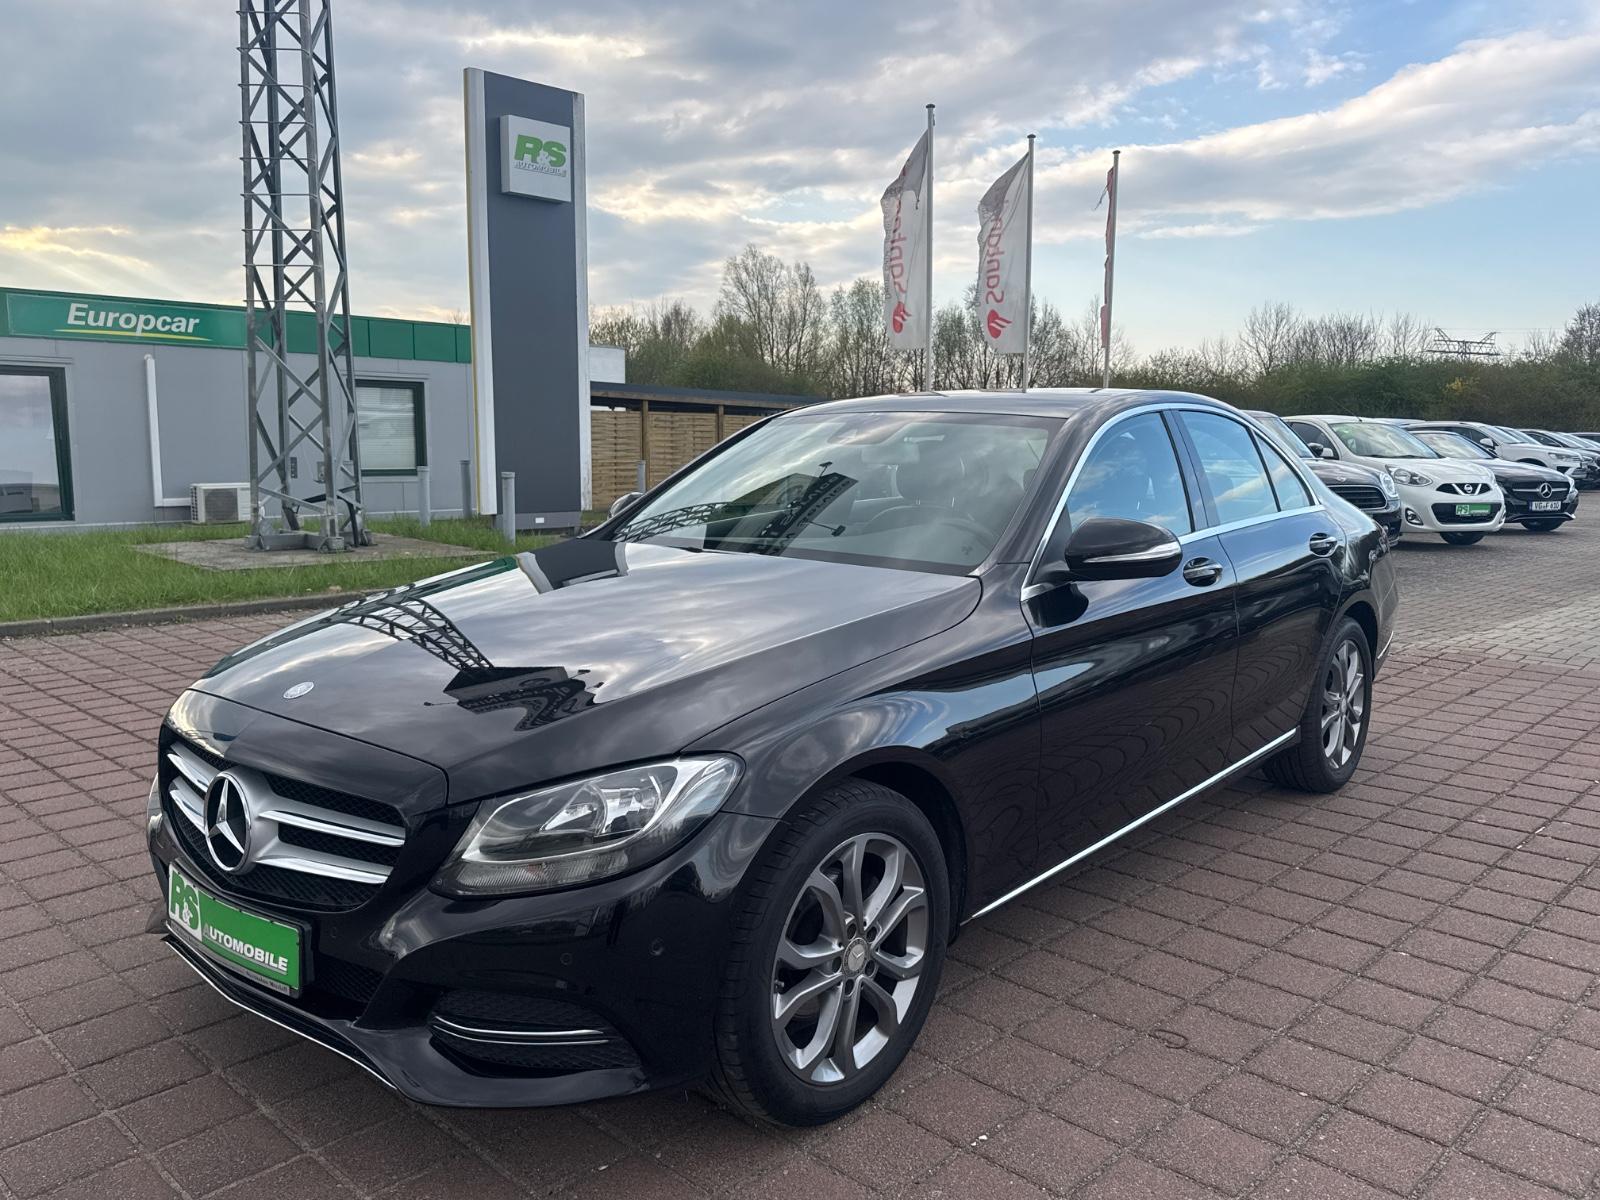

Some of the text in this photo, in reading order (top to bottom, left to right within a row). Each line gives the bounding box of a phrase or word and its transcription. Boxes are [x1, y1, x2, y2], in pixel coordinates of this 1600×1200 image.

[67, 302, 200, 337] Europcar
[172, 869, 200, 931] R&S
[202, 923, 289, 972] AUTOMOBILE
